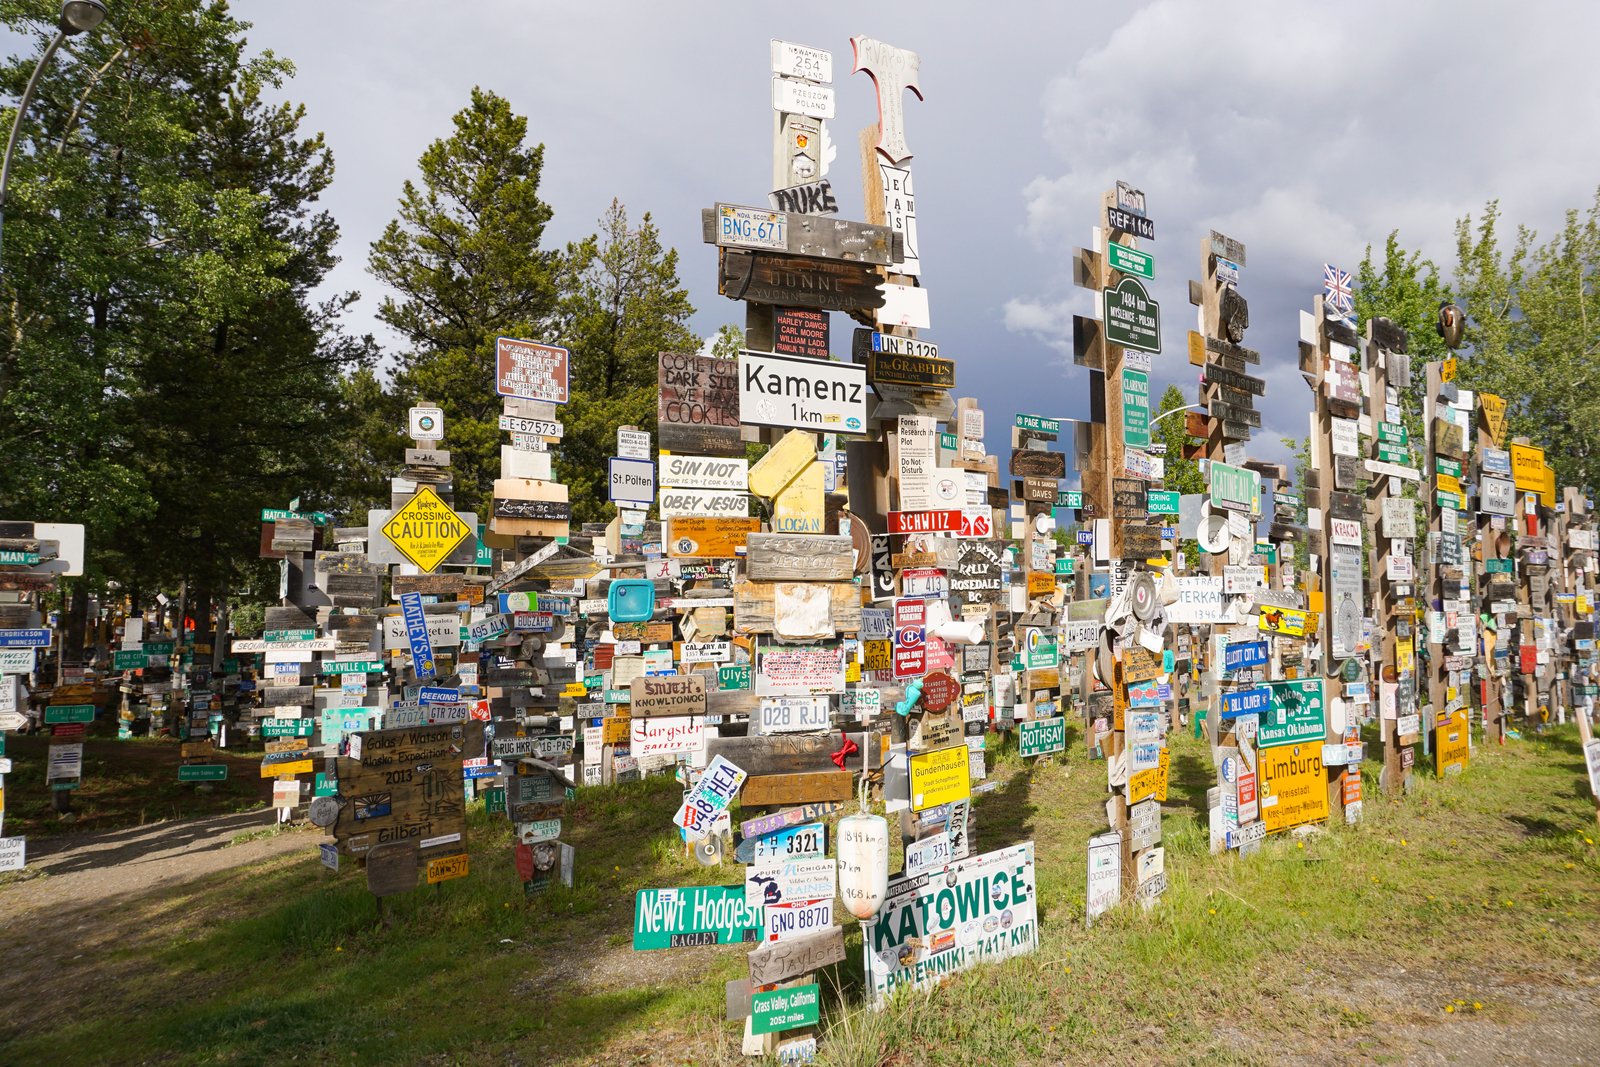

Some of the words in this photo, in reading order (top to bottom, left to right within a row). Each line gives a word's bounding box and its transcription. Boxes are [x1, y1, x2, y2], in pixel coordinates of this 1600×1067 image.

[795, 55, 821, 71] 254
[793, 67, 824, 80] POLAND
[796, 99, 826, 111] POLAND
[723, 217, 783, 242] BNG-671
[1121, 291, 1136, 309] 7484
[1137, 296, 1147, 312] km
[784, 310, 822, 321] TENNESSEE
[778, 317, 803, 328] HARLEY
[804, 320, 828, 331] DAWGS
[781, 326, 799, 336] CARL
[800, 329, 824, 339] MOORE
[780, 335, 807, 346] WILLIAM
[807, 338, 826, 348] LADD
[881, 336, 899, 354] UN
[807, 347, 816, 355] AUG
[817, 348, 828, 357] 2009
[661, 354, 705, 373] COME
[892, 358, 951, 377] GRABELL'S
[666, 371, 700, 388] DARK
[745, 363, 863, 404] Kamenz
[674, 387, 698, 402] WE
[703, 390, 740, 408] HAVE
[1124, 393, 1135, 406] NEW
[1135, 394, 1149, 408] YORK
[666, 401, 740, 427] COOKIES
[509, 421, 557, 436] E-67573
[900, 418, 920, 427] Forest
[1024, 417, 1039, 428] PAGE
[1041, 419, 1060, 431] WHITE
[900, 428, 927, 437] Research
[900, 437, 914, 446] Plot
[670, 459, 703, 476] SIN
[703, 462, 740, 478] NOT
[901, 458, 910, 466] Do
[910, 458, 922, 466] Not
[901, 466, 924, 475] Disturb
[625, 474, 652, 486] Pölten
[1032, 489, 1053, 500] DAVES
[1489, 484, 1501, 494] City
[1503, 486, 1510, 495] of
[663, 495, 704, 511] OBEY
[704, 497, 747, 512] JESUS
[1488, 496, 1509, 510] Winkler
[401, 511, 452, 521] CROSSING
[899, 511, 950, 531] SCHWIIZ
[390, 521, 461, 539] CAUTION
[777, 517, 820, 532] LOGAN
[926, 576, 941, 592] 413
[950, 578, 1000, 591] ROSEDALE
[968, 591, 983, 603] BC
[897, 605, 924, 614] RESERVED
[899, 612, 922, 622] PARKING
[472, 624, 487, 639] 495
[489, 617, 508, 634] ALK
[270, 641, 297, 651] SENIOR
[298, 641, 329, 651] CENTER
[897, 652, 911, 661] FANS
[911, 650, 924, 659] ONLY
[421, 691, 458, 702] SEEKINS
[787, 699, 810, 707] Québec
[1231, 698, 1243, 713] BILL
[1243, 695, 1261, 711] OLIVER
[1273, 688, 1308, 708] Welcome
[431, 708, 446, 720] GTR
[447, 707, 466, 720] 7249
[763, 707, 790, 725] 028
[800, 706, 827, 725] RJJ
[1287, 707, 1296, 719] to
[261, 717, 296, 729] ABILENE
[409, 731, 449, 745] Watson
[1021, 726, 1063, 748] ROTHSAY
[1259, 727, 1286, 741] Kansas
[1287, 723, 1324, 738] Oklahoma
[499, 742, 515, 757] RUG
[516, 741, 530, 754] HKR
[362, 754, 393, 768] Alaska
[398, 748, 446, 764] Expedition
[914, 760, 966, 778] Gündenhausen
[1264, 755, 1321, 780] Limburg
[385, 769, 413, 785] 2013
[708, 763, 739, 797] HEA
[688, 777, 709, 804] Oregon
[923, 787, 943, 796] Landkreis
[1278, 786, 1310, 799] Kreisstadt
[377, 821, 433, 843] Gilbert
[786, 833, 819, 854] 3321
[865, 836, 876, 844] km
[933, 842, 949, 858] 331
[760, 869, 781, 877] PURE
[786, 883, 833, 897] RAINES
[638, 889, 687, 934] Newt
[791, 900, 809, 908] OHIO
[872, 865, 1029, 954] KATOWICE
[798, 906, 829, 929] 8870
[671, 932, 718, 948] RAGLEY
[743, 929, 758, 942] LA
[1010, 923, 1031, 949] KM
[753, 999, 770, 1014] Grass
[769, 997, 789, 1014] Valley,
[789, 991, 816, 1007] California
[769, 1016, 786, 1027] 2052
[786, 1013, 805, 1024] miles
